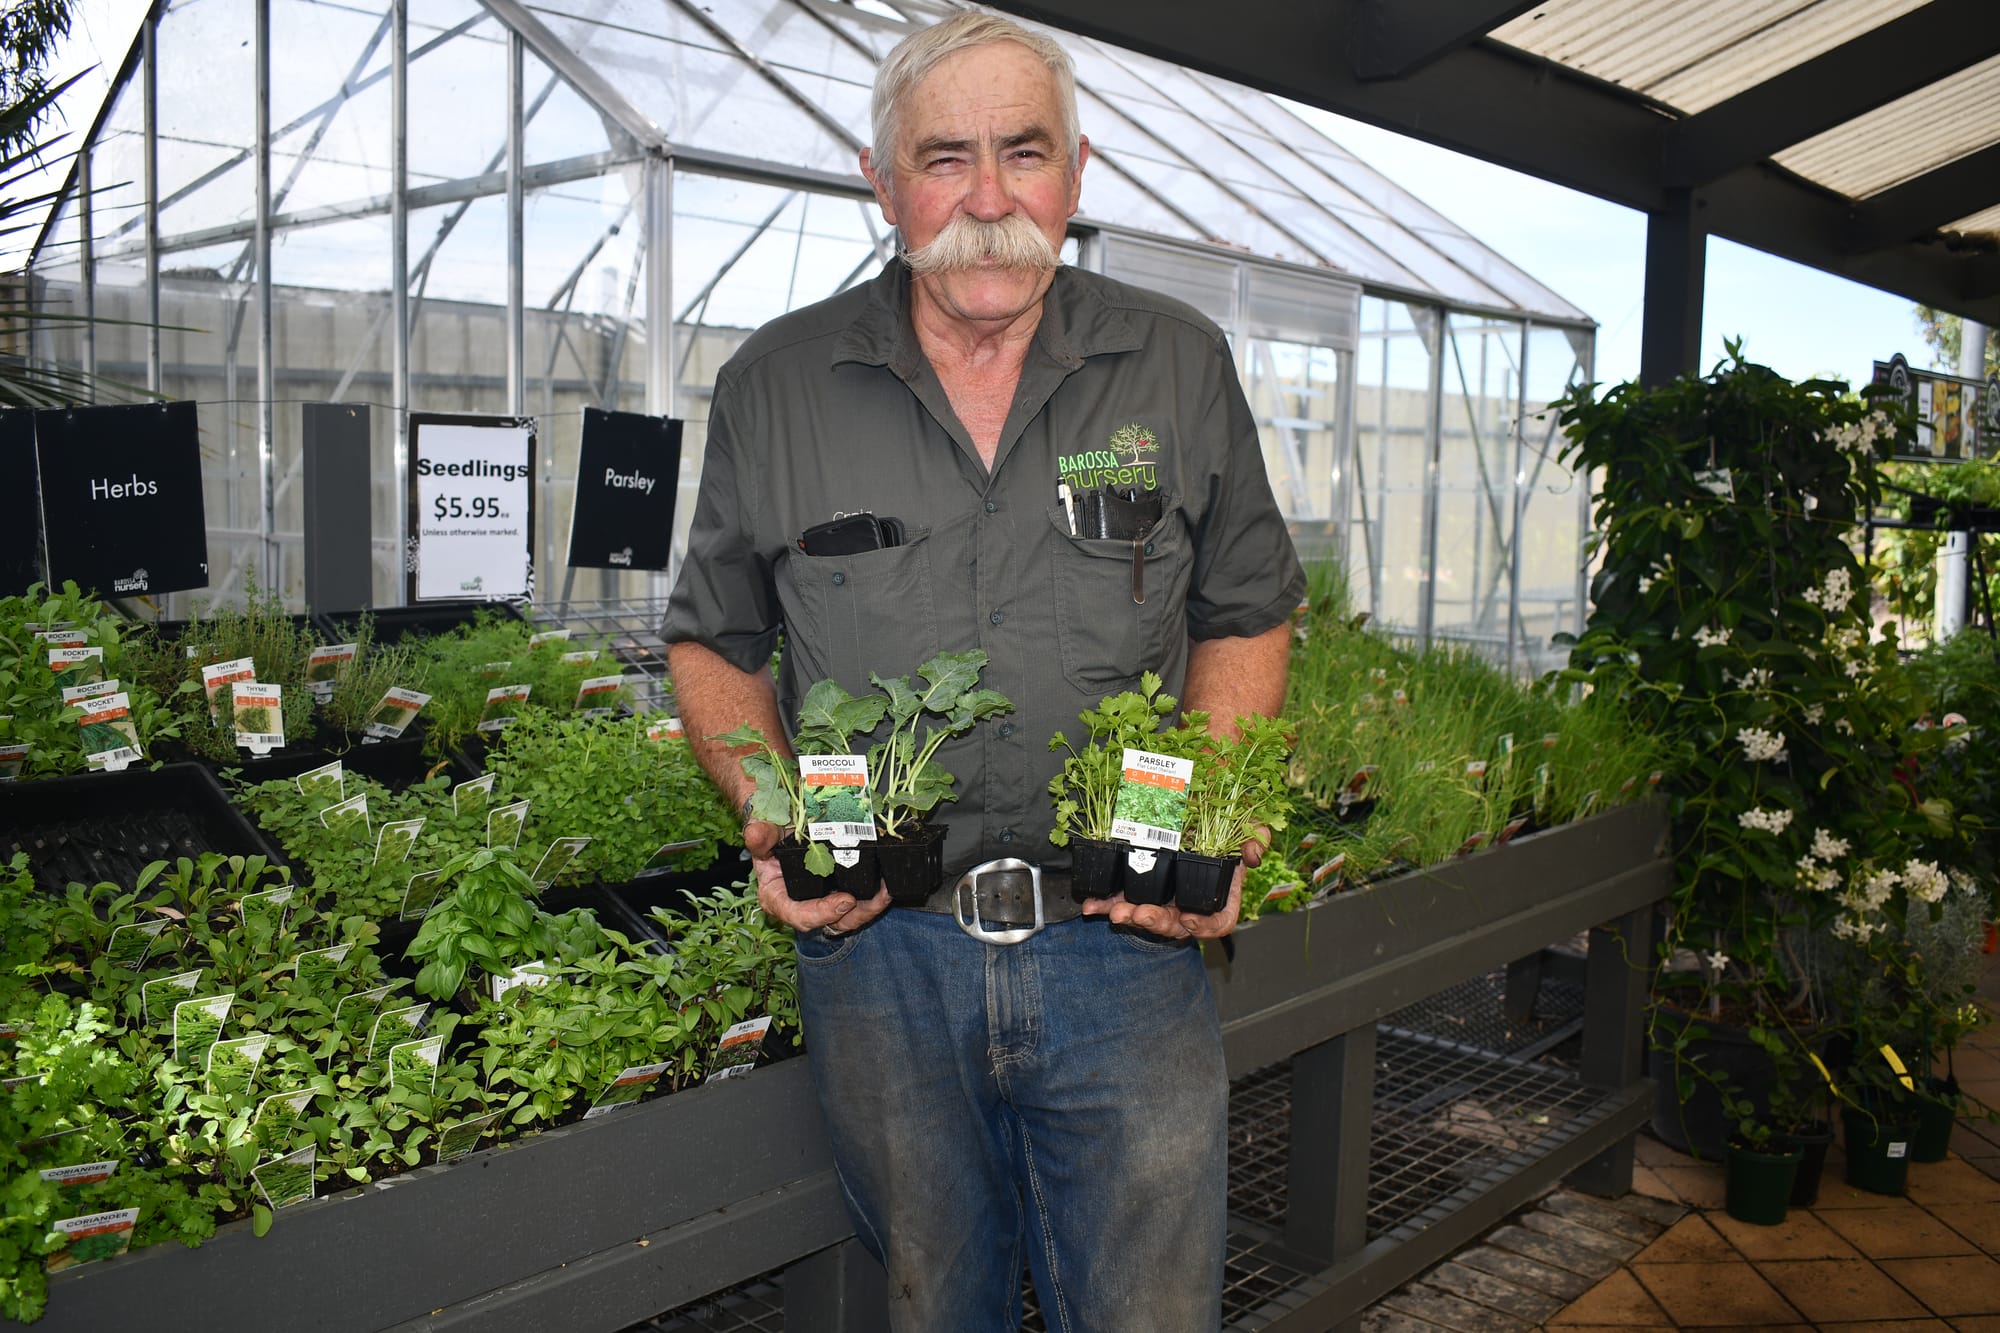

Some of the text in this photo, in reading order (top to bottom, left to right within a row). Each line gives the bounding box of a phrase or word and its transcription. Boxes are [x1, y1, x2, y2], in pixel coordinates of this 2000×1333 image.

[1058, 450, 1119, 473] BAROSSA
[417, 458, 528, 482] Seedlings
[604, 468, 656, 495] Parsley
[1063, 466, 1158, 491] nursery
[91, 473, 158, 500] Herbs
[434, 493, 500, 522] $5.95
[422, 528, 448, 536] Unless
[449, 528, 487, 536] otherwise
[114, 581, 148, 593] nursery
[48, 632, 75, 640] ROCKET
[216, 662, 239, 673] THYME
[77, 683, 106, 694] ROCKET
[87, 697, 115, 709] ROCKET
[811, 759, 856, 767] BROCCOLI
[1139, 755, 1176, 769] PARSLEY
[738, 1022, 755, 1032] BASIL
[48, 1164, 108, 1178] CORIANDER
[66, 1211, 129, 1229] CORIANDER
